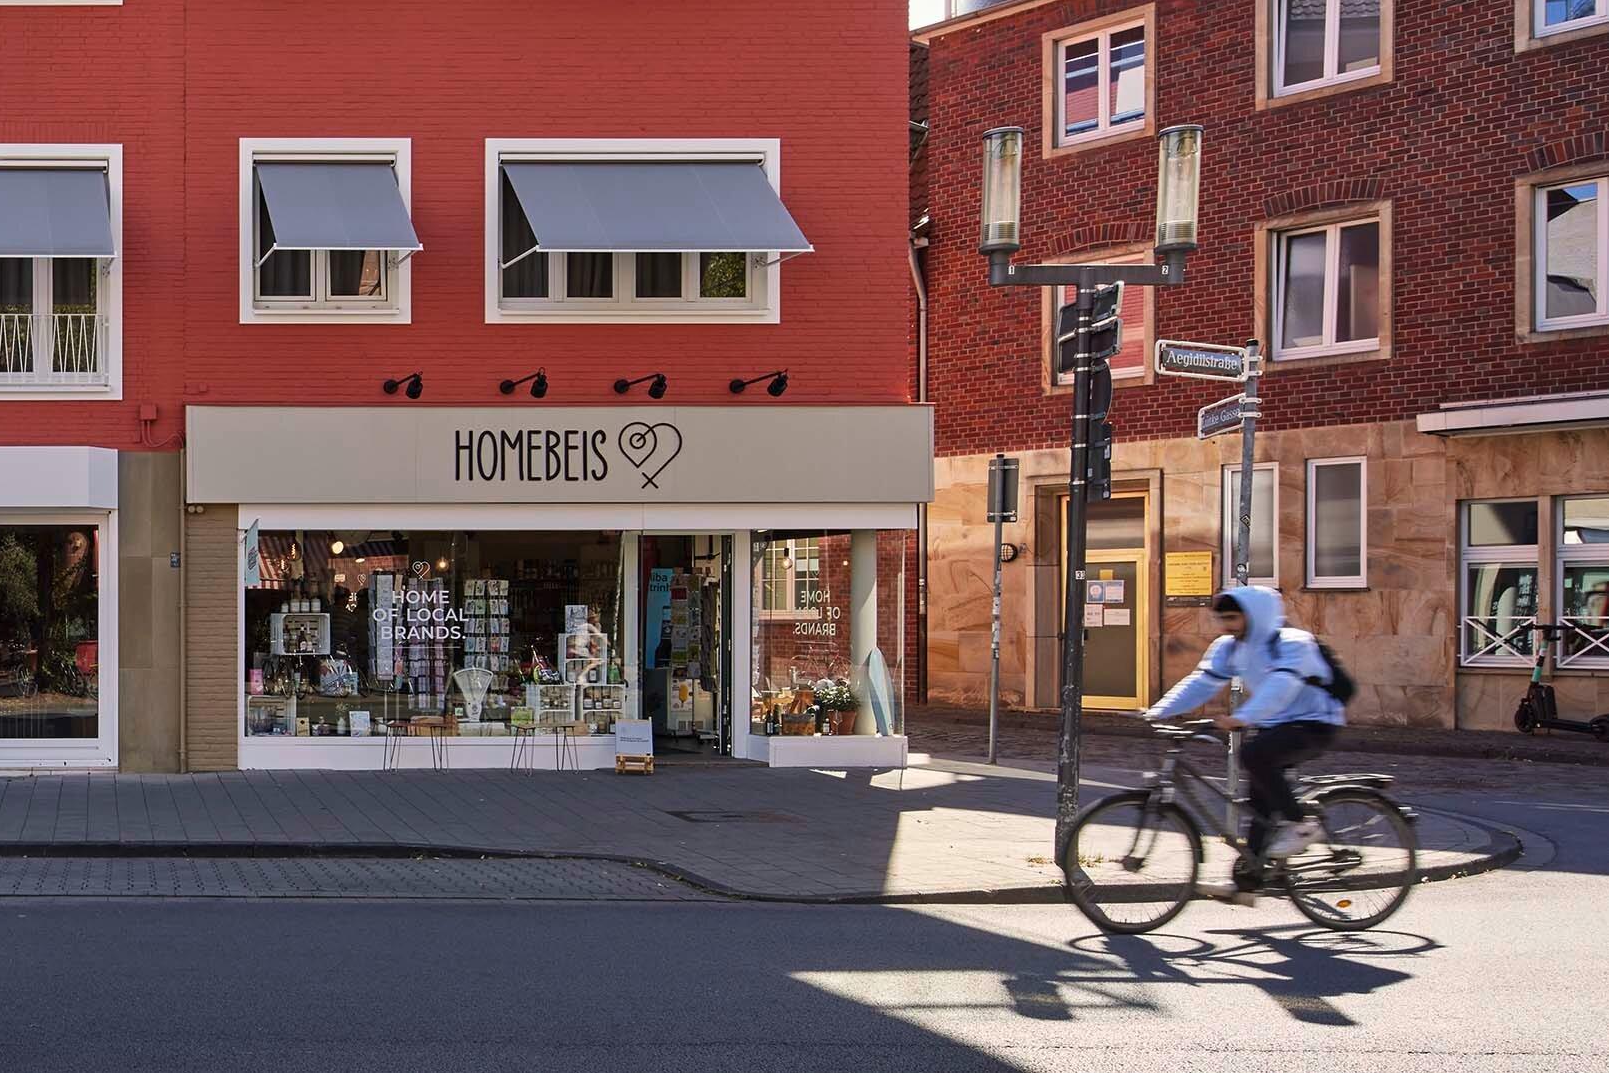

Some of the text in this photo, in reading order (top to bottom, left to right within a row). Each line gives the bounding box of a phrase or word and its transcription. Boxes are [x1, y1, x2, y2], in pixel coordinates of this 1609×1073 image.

[1166, 350, 1238, 370] Aegidiistraße
[454, 429, 608, 482] HOMEBEIS
[392, 590, 449, 604] HOME
[373, 608, 469, 622] OF LOCAL
[381, 626, 466, 640] BRANDS.
